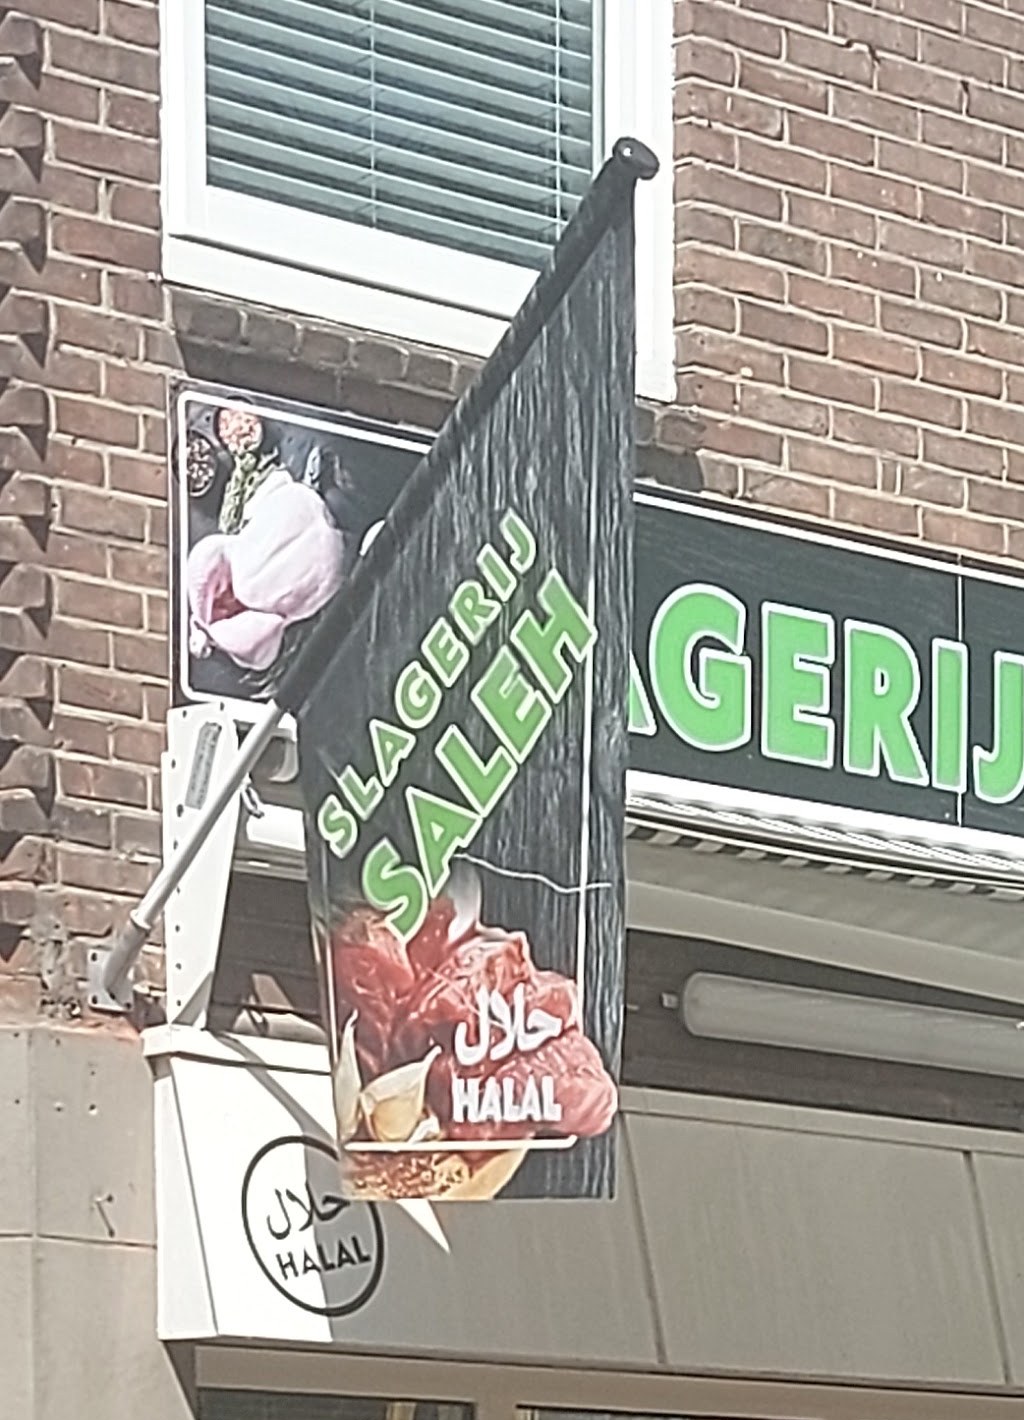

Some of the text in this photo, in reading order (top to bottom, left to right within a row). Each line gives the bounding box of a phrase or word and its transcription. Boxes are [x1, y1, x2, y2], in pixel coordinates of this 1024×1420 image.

[317, 510, 538, 859] SLAGERIJ
[361, 567, 598, 940] SALEH
[454, 981, 563, 1066] حلال
[453, 1075, 563, 1123] HALAL
[266, 1180, 351, 1241] حلال
[275, 1235, 372, 1281] HALAL
